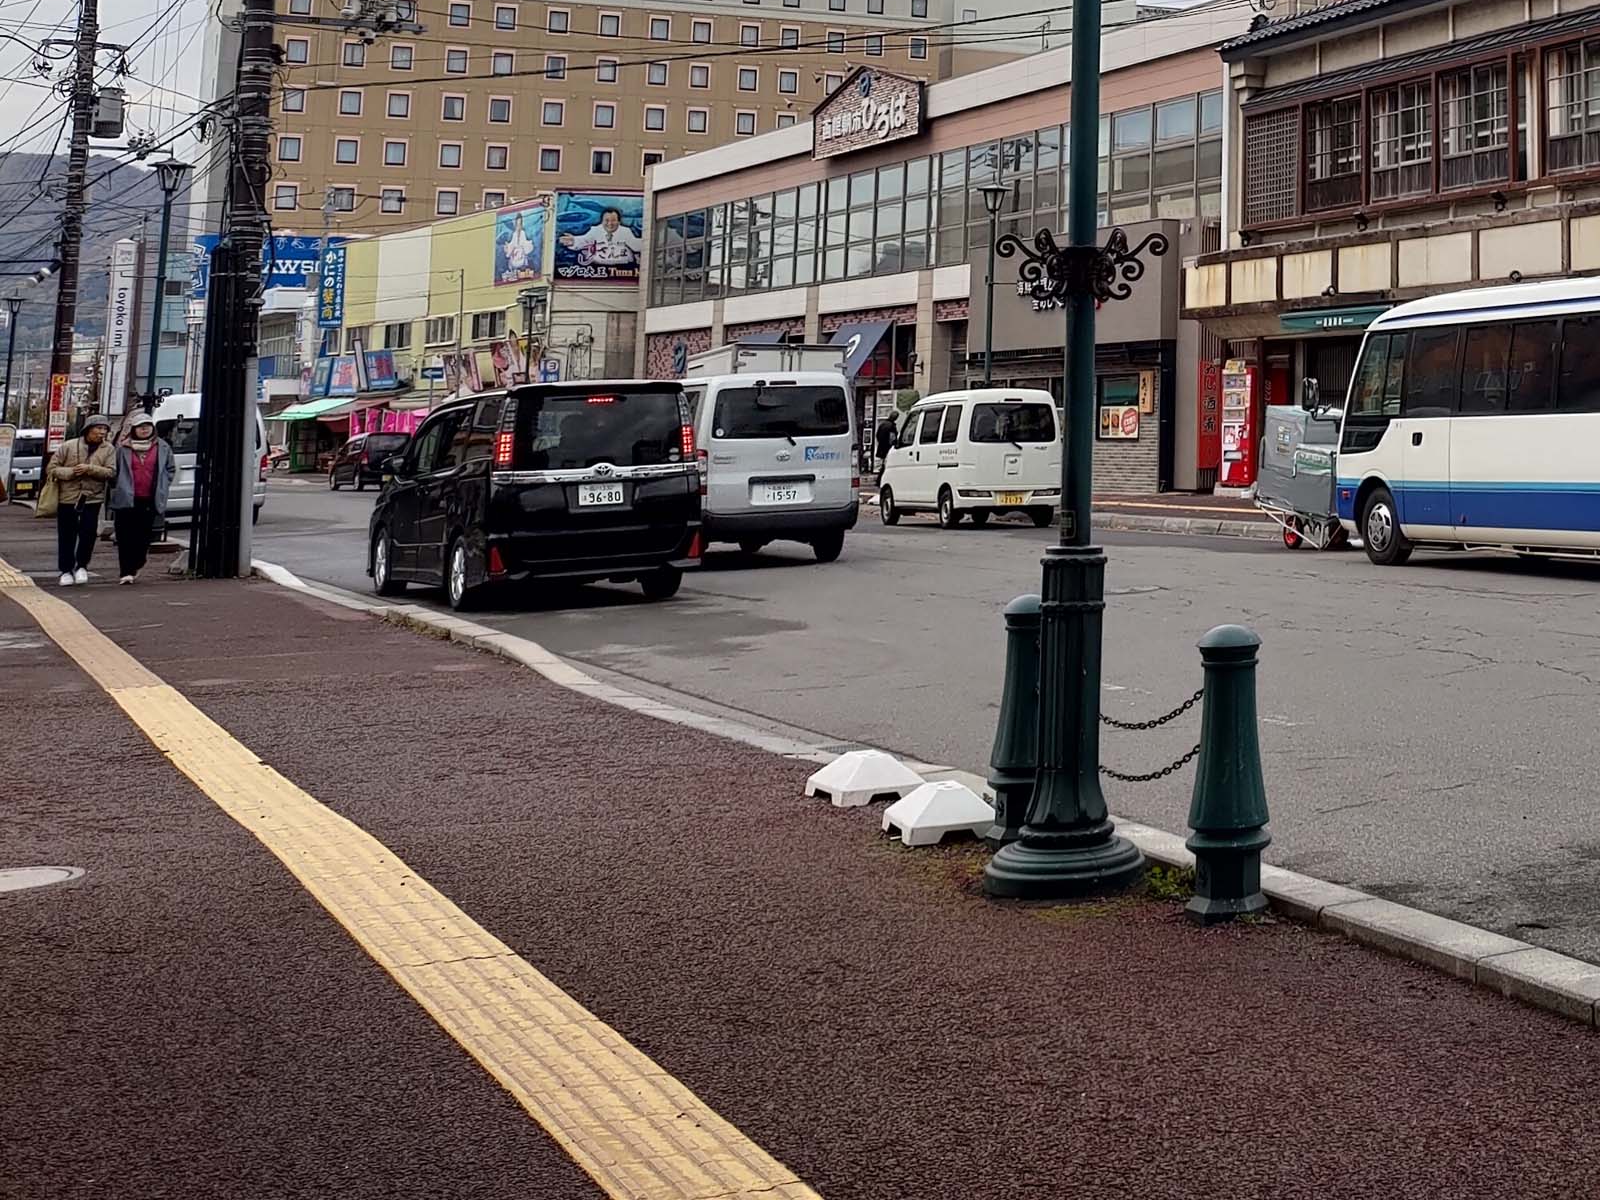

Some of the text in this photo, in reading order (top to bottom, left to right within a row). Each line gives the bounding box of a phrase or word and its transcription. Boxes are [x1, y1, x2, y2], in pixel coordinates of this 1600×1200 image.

[113, 287, 129, 348] toyoko inn
[588, 490, 621, 503] 96-80
